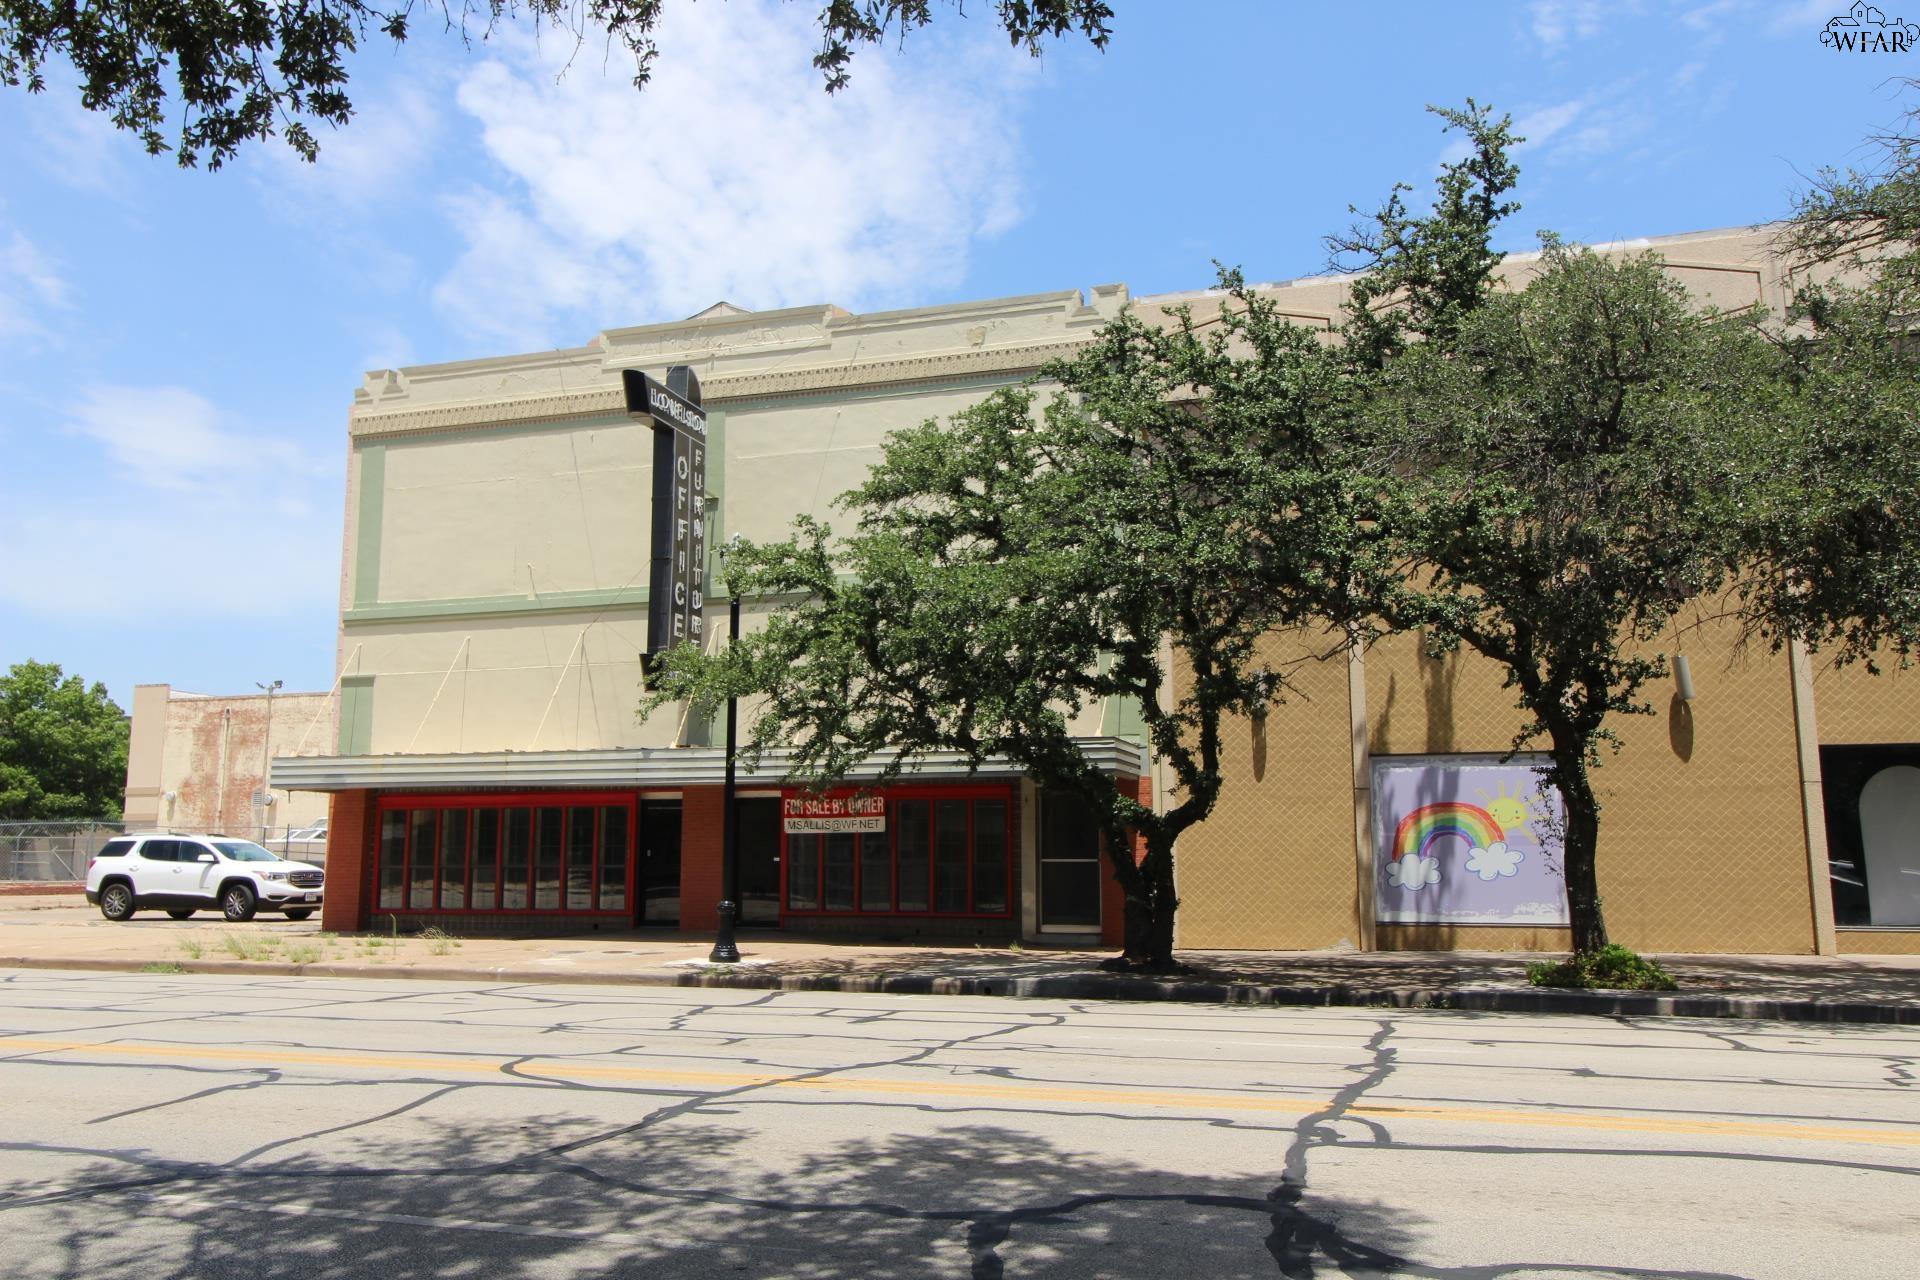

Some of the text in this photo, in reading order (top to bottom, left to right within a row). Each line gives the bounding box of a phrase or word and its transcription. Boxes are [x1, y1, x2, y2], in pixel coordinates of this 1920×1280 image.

[673, 455, 689, 638] OFFICE
[784, 796, 884, 815] FOR SALE BY OWNER
